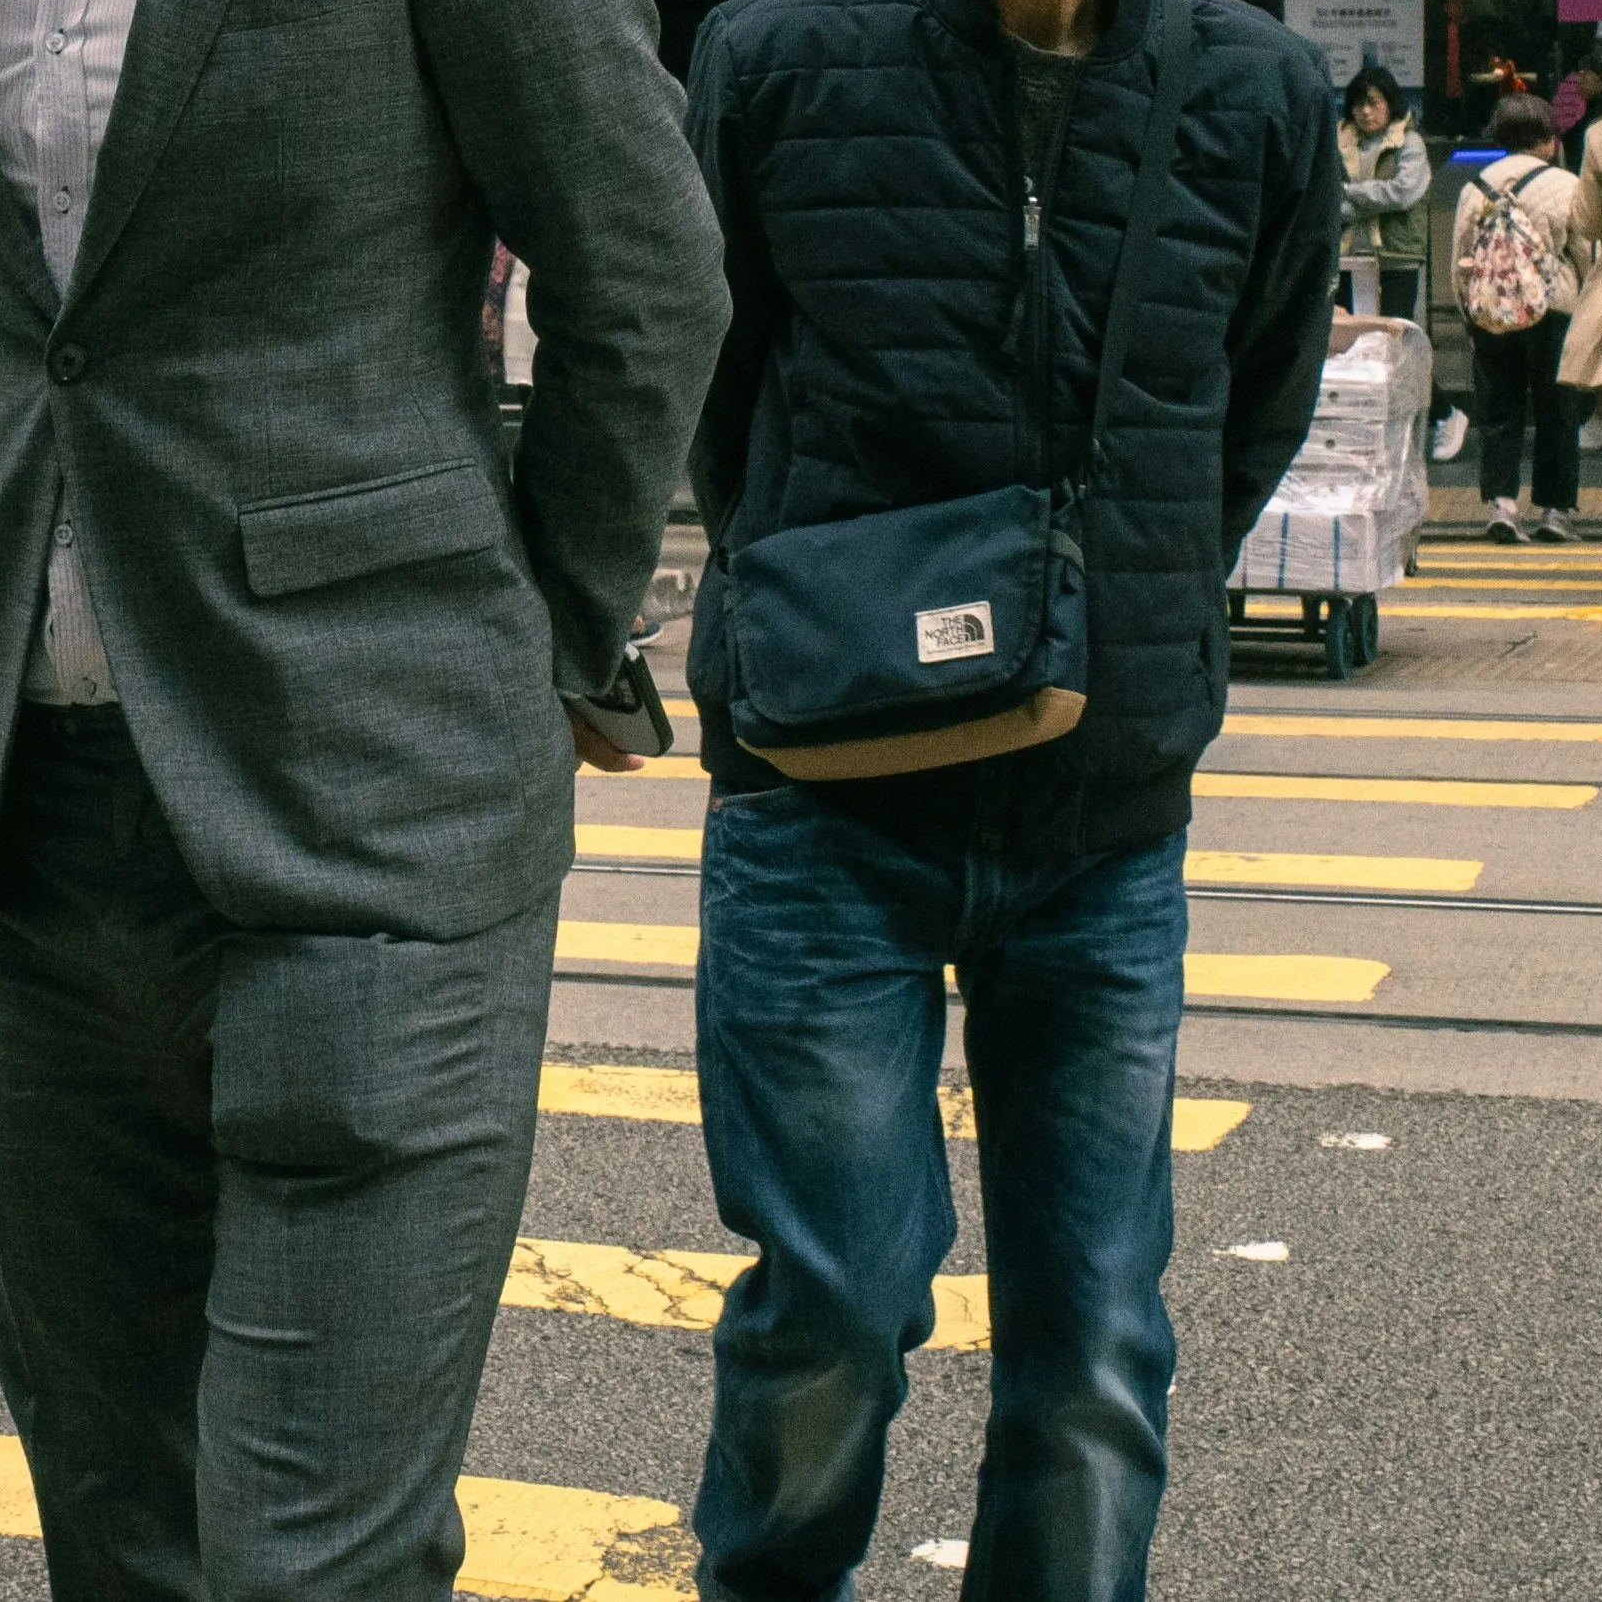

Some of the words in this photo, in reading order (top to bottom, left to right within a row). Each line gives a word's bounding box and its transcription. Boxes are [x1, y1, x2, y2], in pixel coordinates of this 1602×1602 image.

[940, 615, 962, 628] THE
[924, 624, 965, 640] NORTH
[936, 633, 965, 648] FACE
